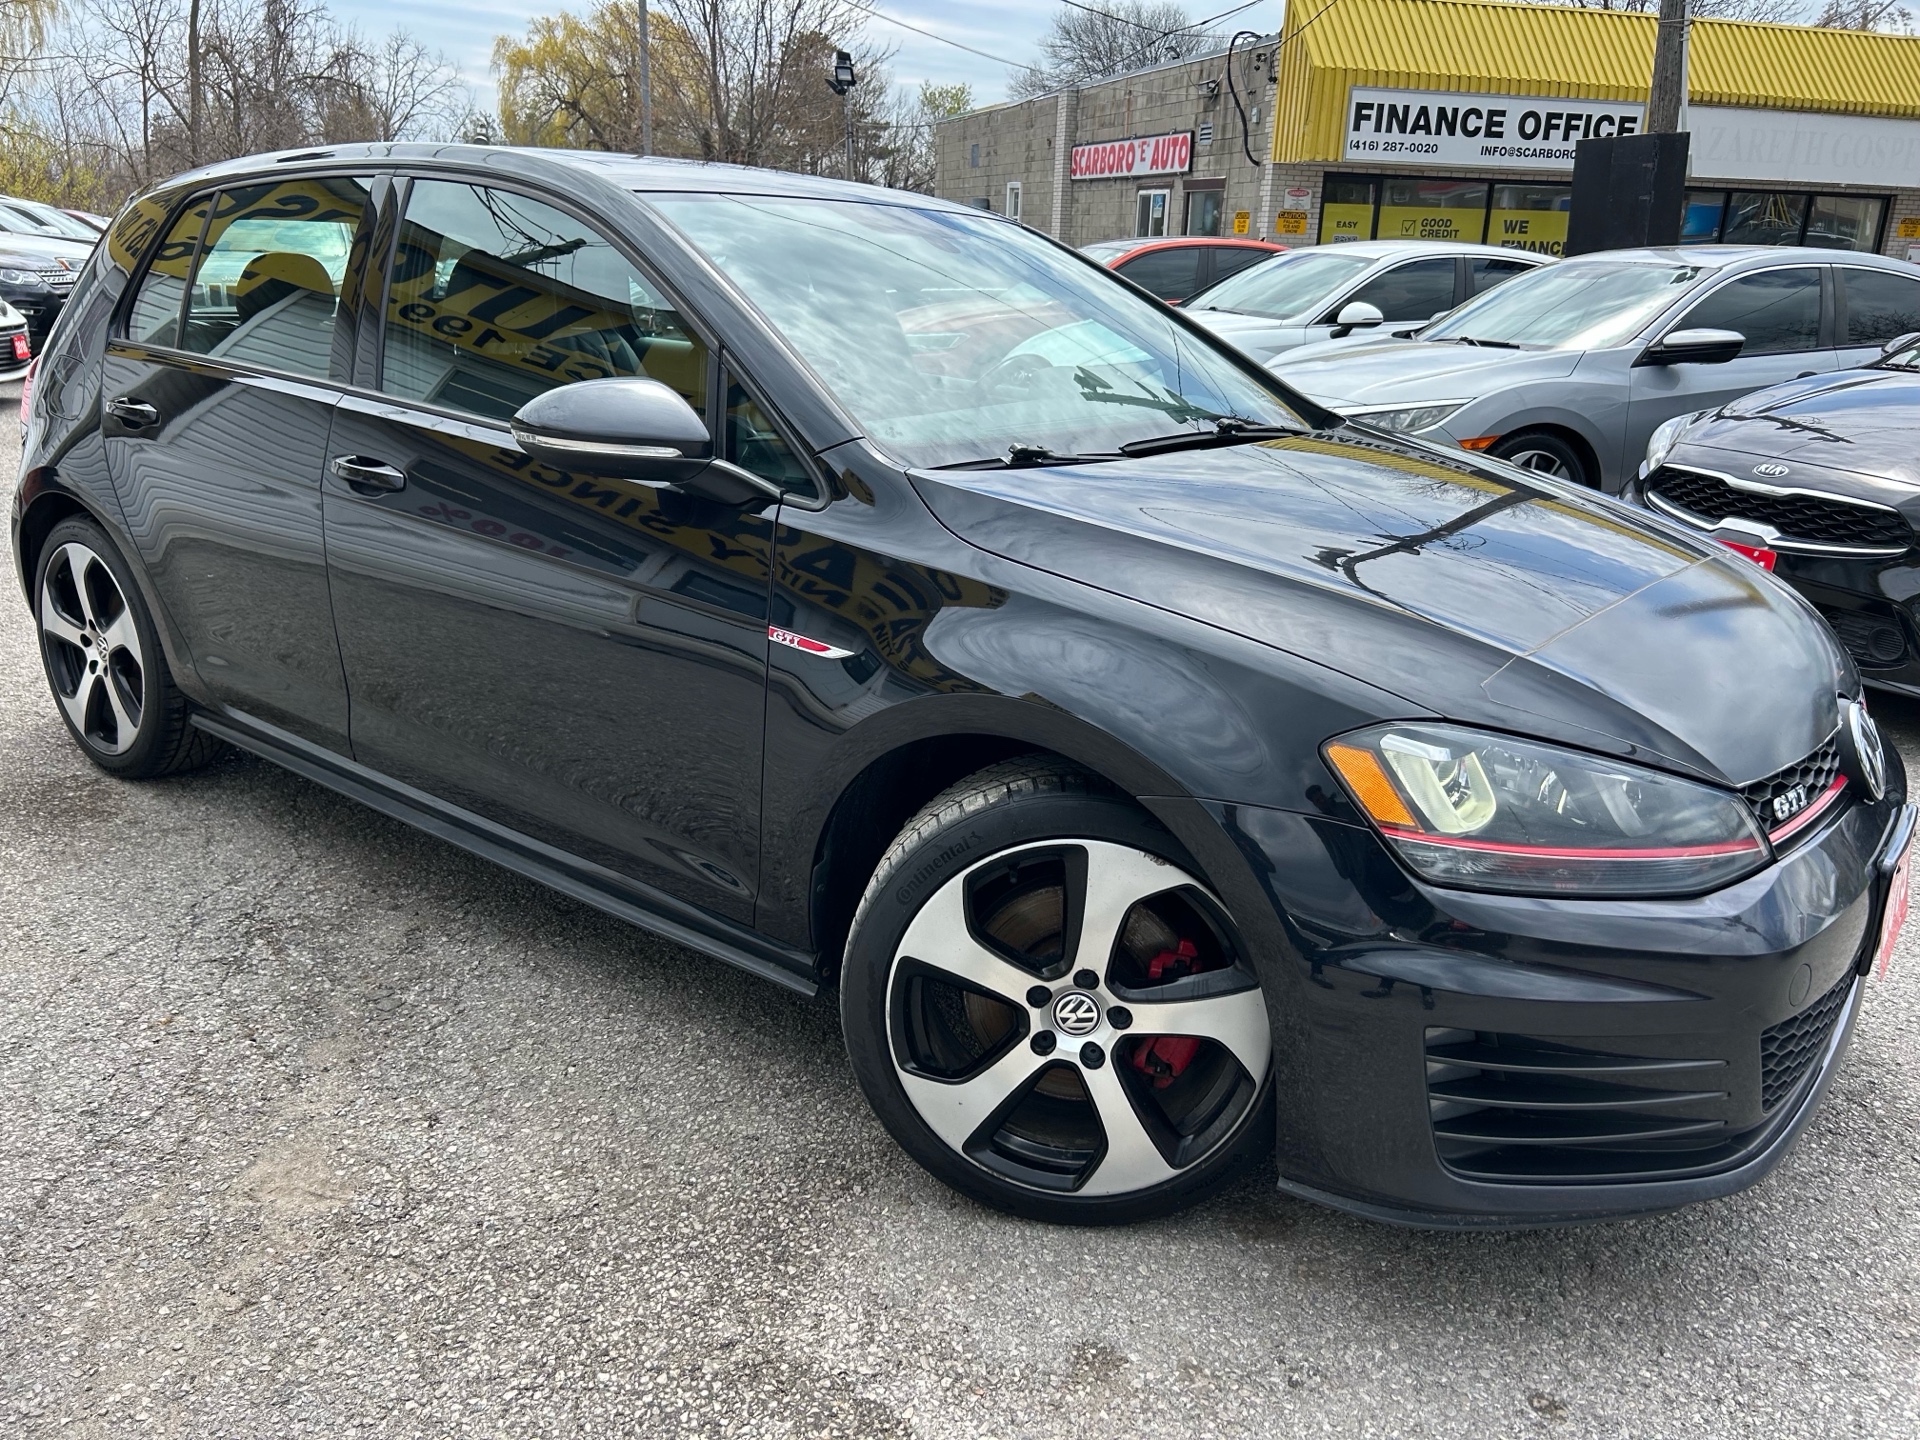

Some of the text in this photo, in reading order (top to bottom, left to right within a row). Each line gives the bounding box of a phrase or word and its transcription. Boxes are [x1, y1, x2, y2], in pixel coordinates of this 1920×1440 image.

[1352, 101, 1639, 142] FINANCE OFFICE
[1349, 139, 1438, 154] (416) 287-0020
[1071, 141, 1136, 177] SCARBORO
[1149, 135, 1190, 171] AUTO
[1279, 211, 1307, 219] CAUTION
[1336, 220, 1358, 229] EASY
[1421, 218, 1453, 229] GOOD
[1503, 219, 1530, 235] WE
[1420, 228, 1460, 239] CREDIT
[1756, 463, 1786, 475] KIA
[772, 630, 801, 648] GTI
[1773, 784, 1809, 822] GTI
[895, 835, 972, 906] Continental
